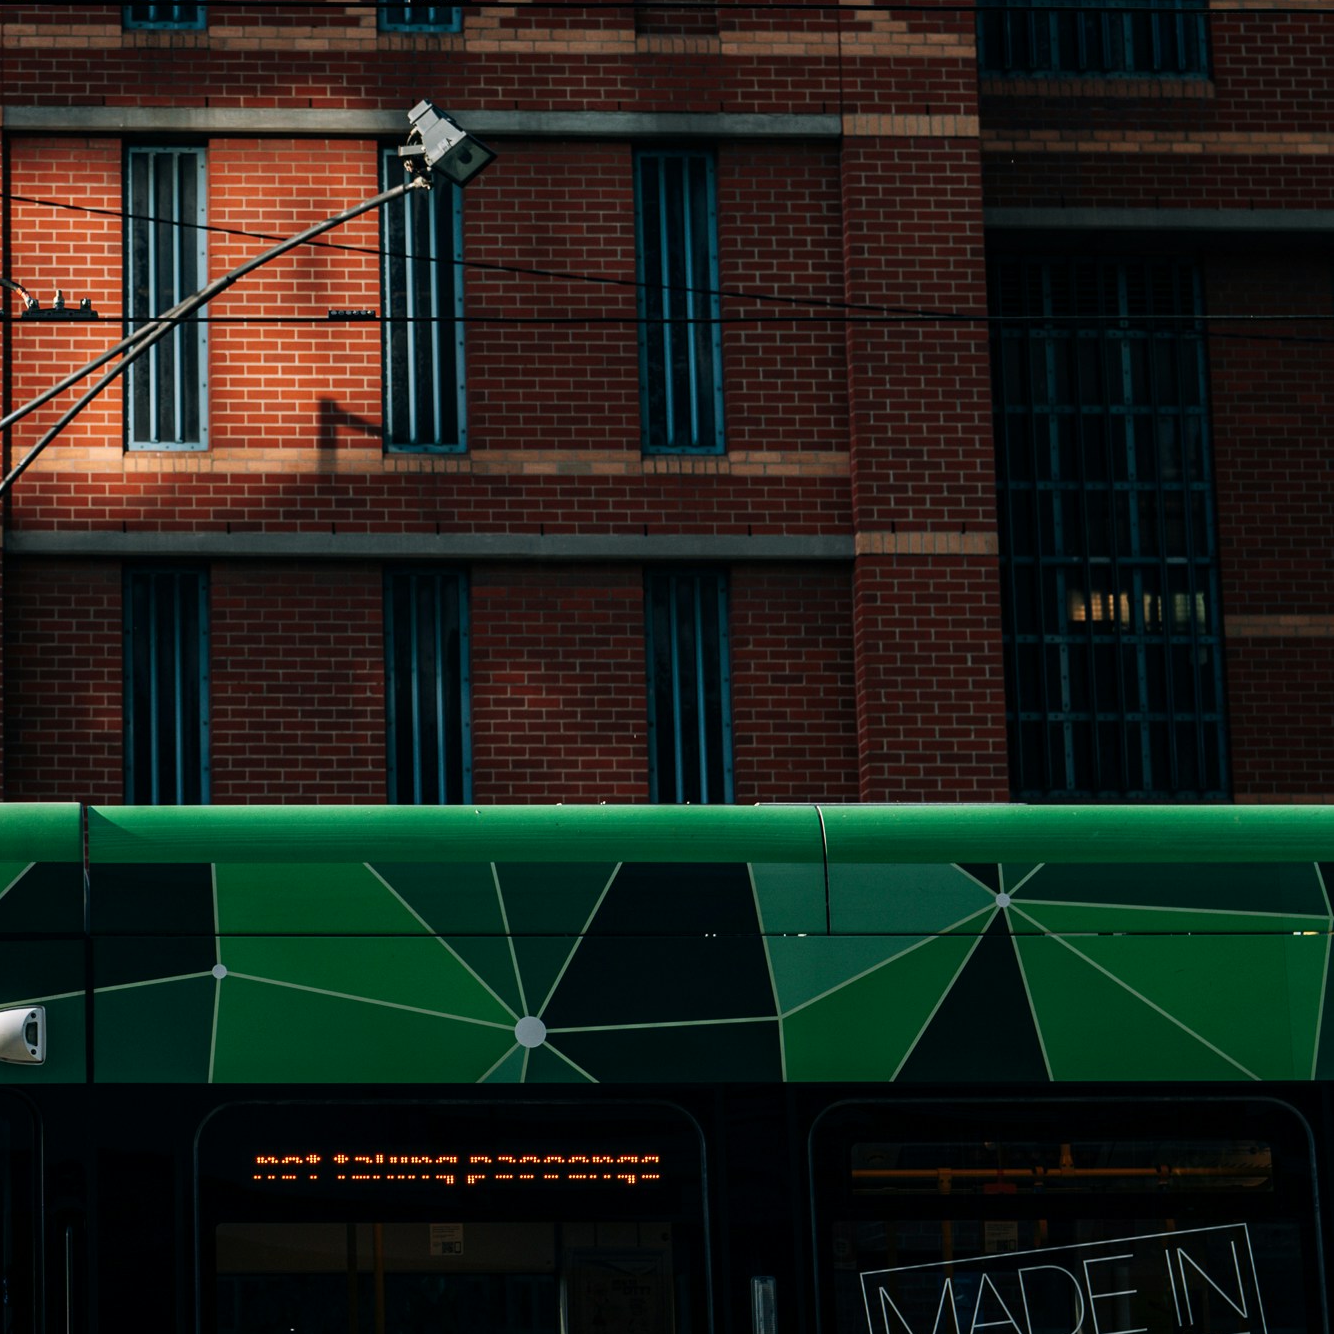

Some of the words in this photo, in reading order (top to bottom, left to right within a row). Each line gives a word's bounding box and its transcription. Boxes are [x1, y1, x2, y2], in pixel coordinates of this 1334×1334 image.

[253, 1153, 321, 1180] not
[334, 1153, 456, 1185] taking
[1165, 1240, 1248, 1327] IN
